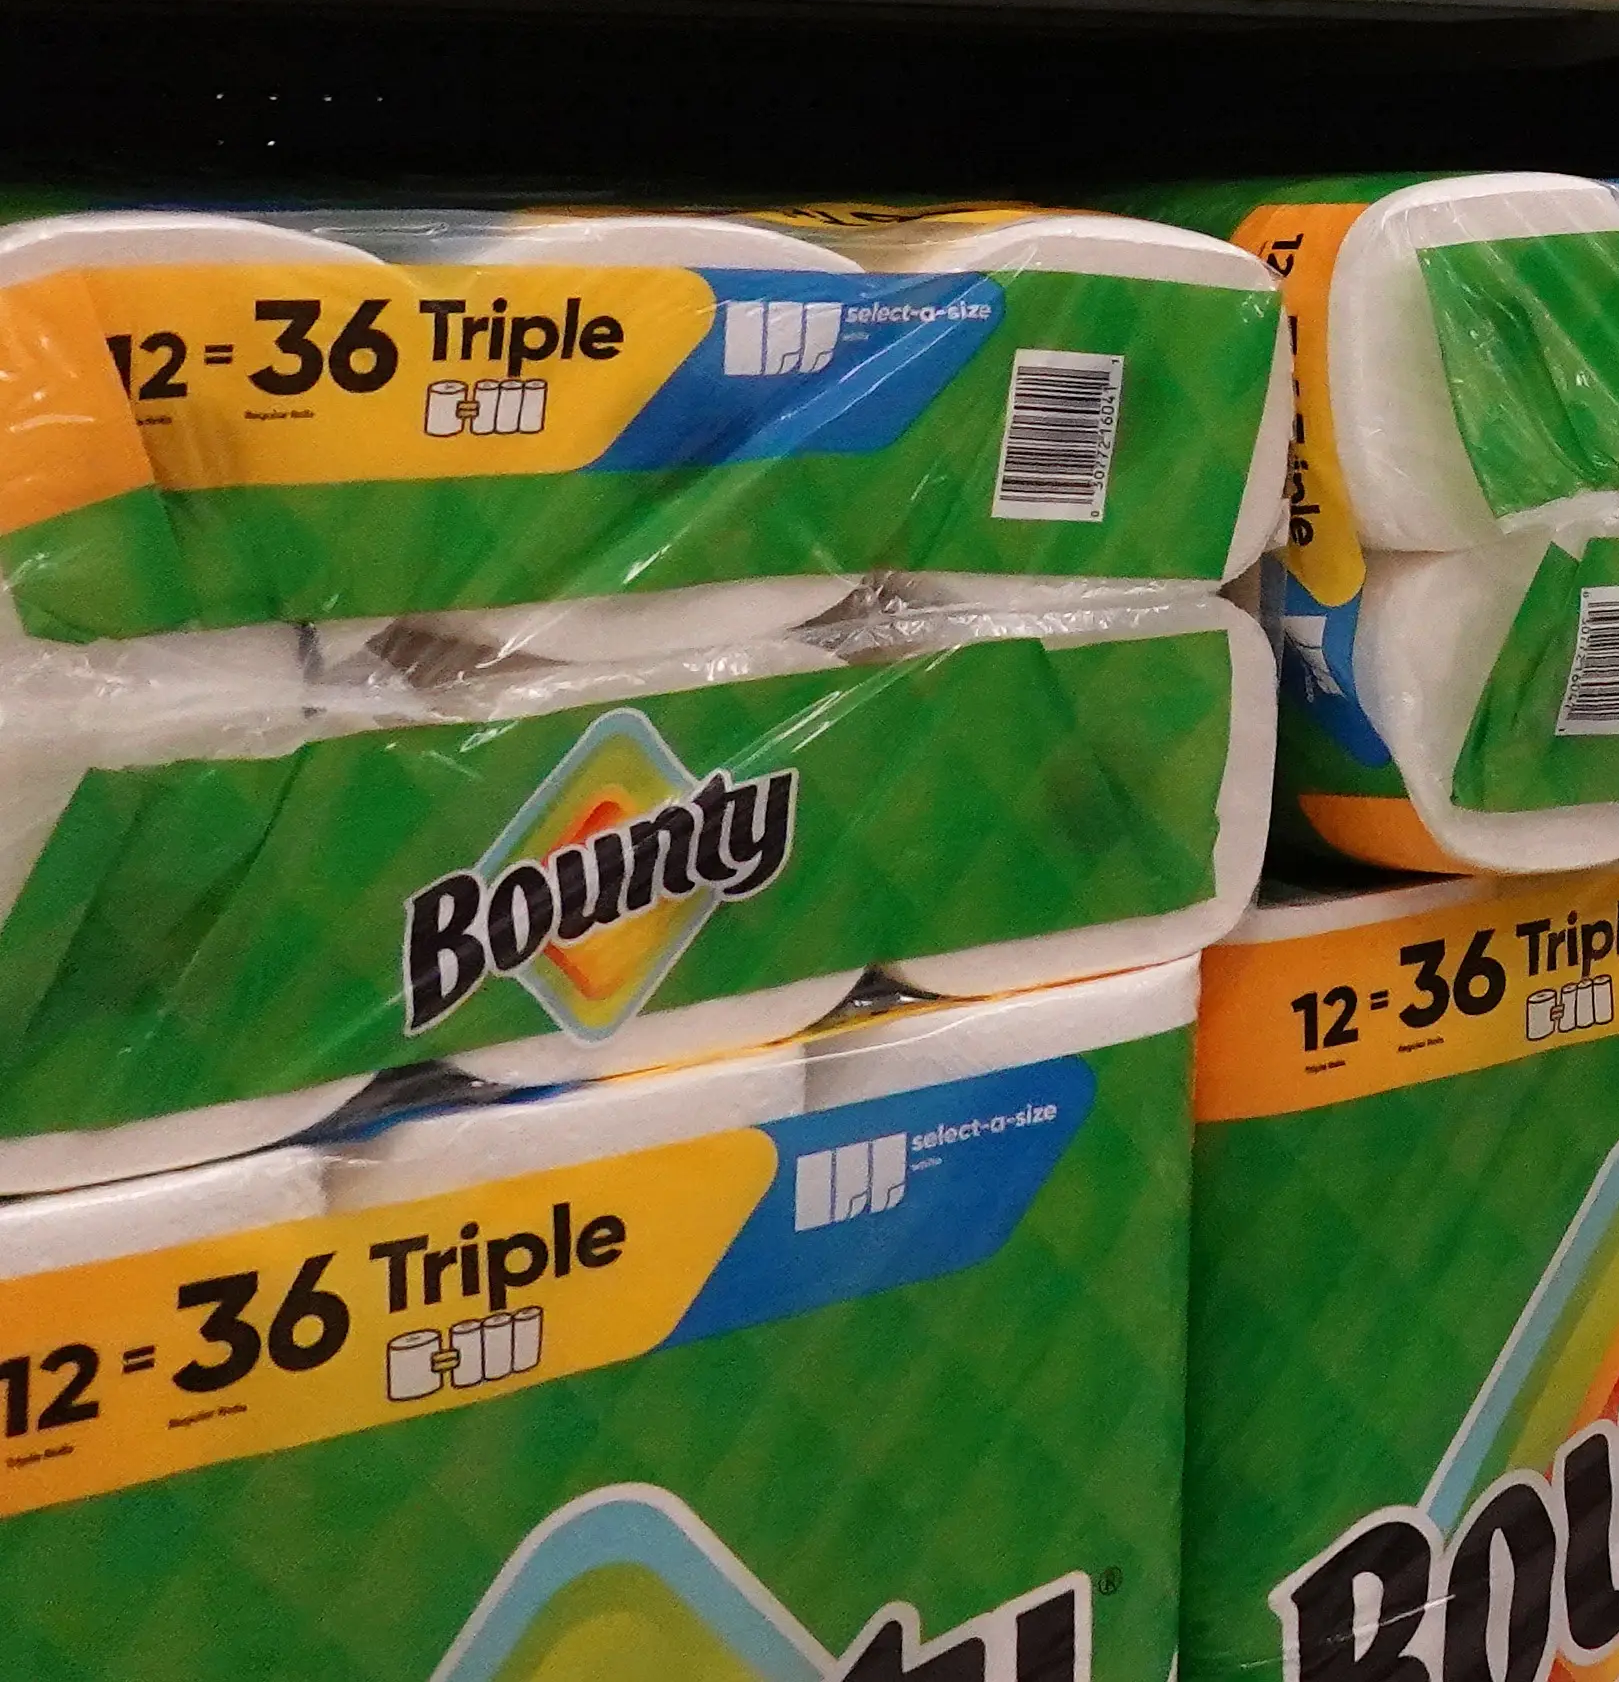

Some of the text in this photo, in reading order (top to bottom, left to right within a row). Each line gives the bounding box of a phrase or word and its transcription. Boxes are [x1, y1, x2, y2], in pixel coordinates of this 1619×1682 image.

[420, 297, 625, 378] Triple
[845, 300, 992, 326] select-a-size
[409, 771, 792, 1030] Bounty
[910, 1101, 1058, 1152] select-a-size
[370, 1202, 626, 1313] Triple
